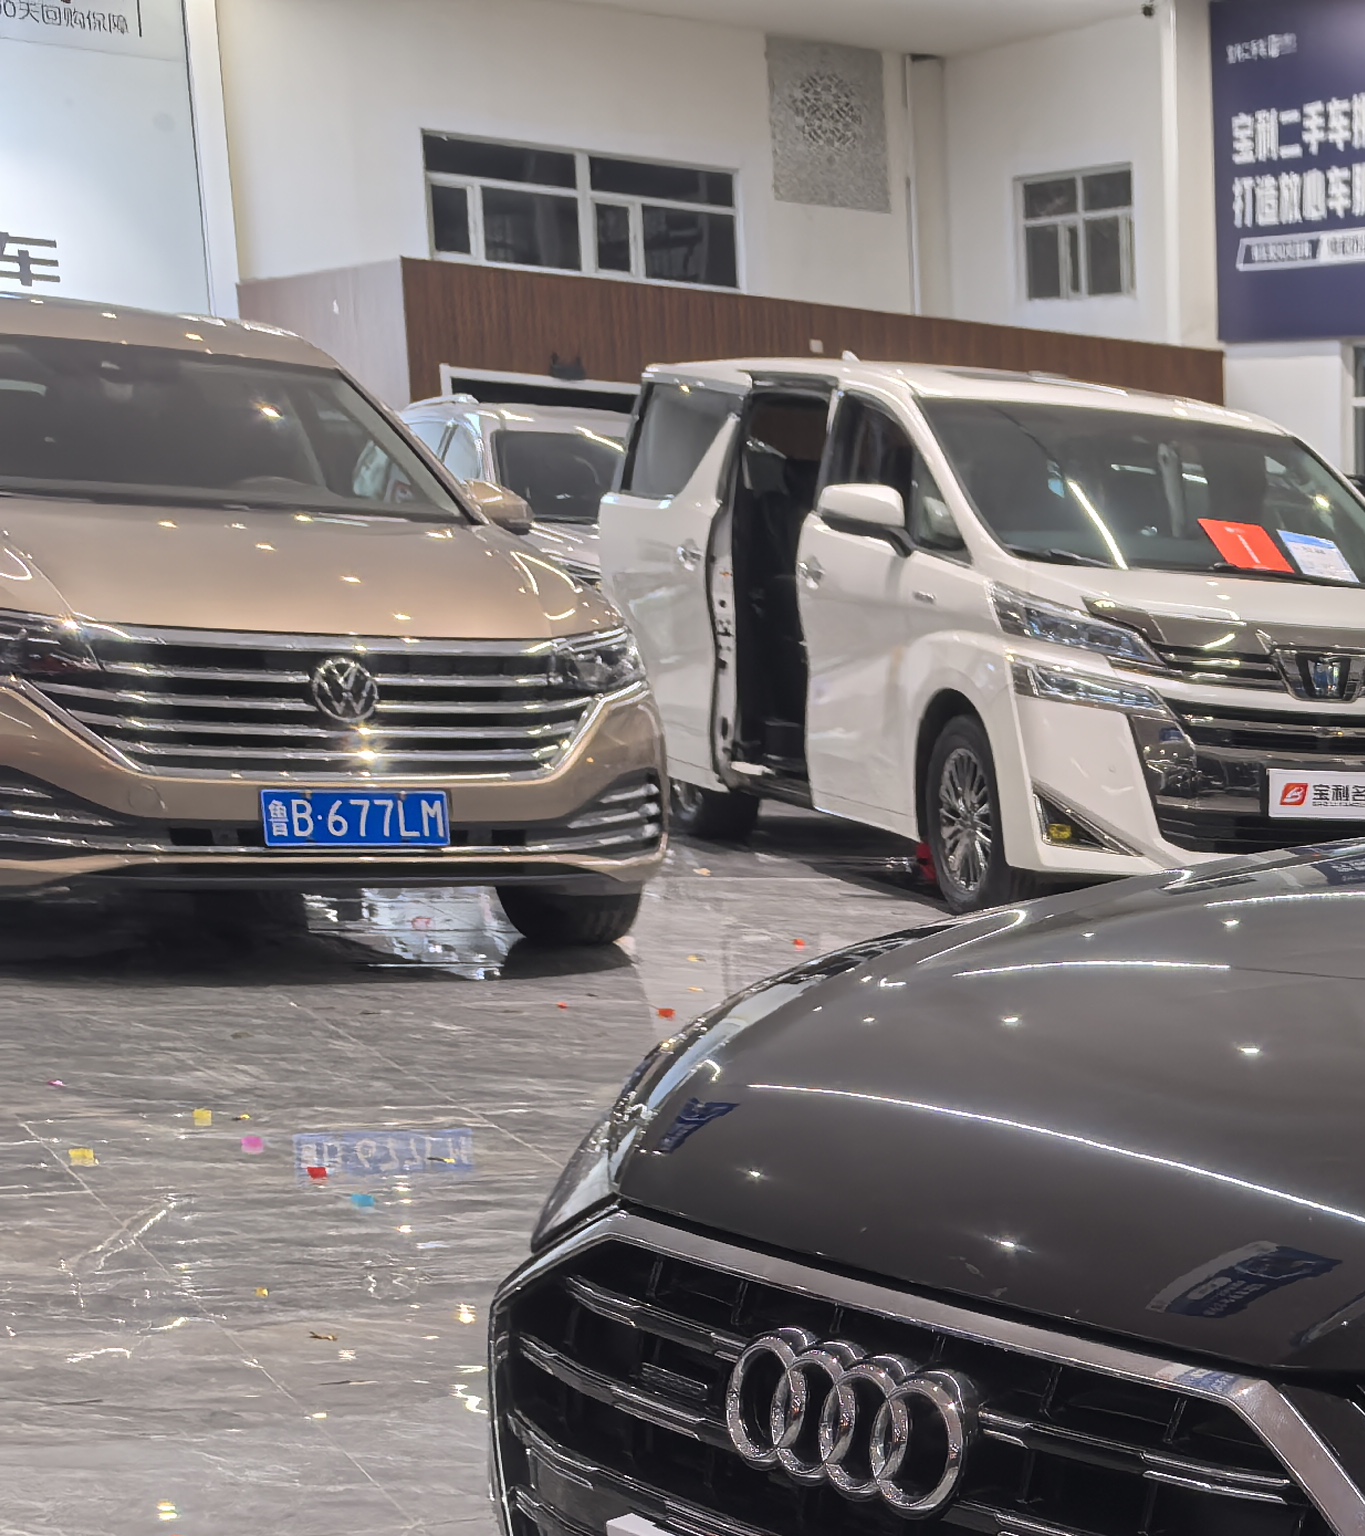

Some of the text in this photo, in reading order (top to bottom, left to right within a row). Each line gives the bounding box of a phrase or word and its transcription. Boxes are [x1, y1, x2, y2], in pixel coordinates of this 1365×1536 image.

[0, 0, 128, 34] 0天回购保障
